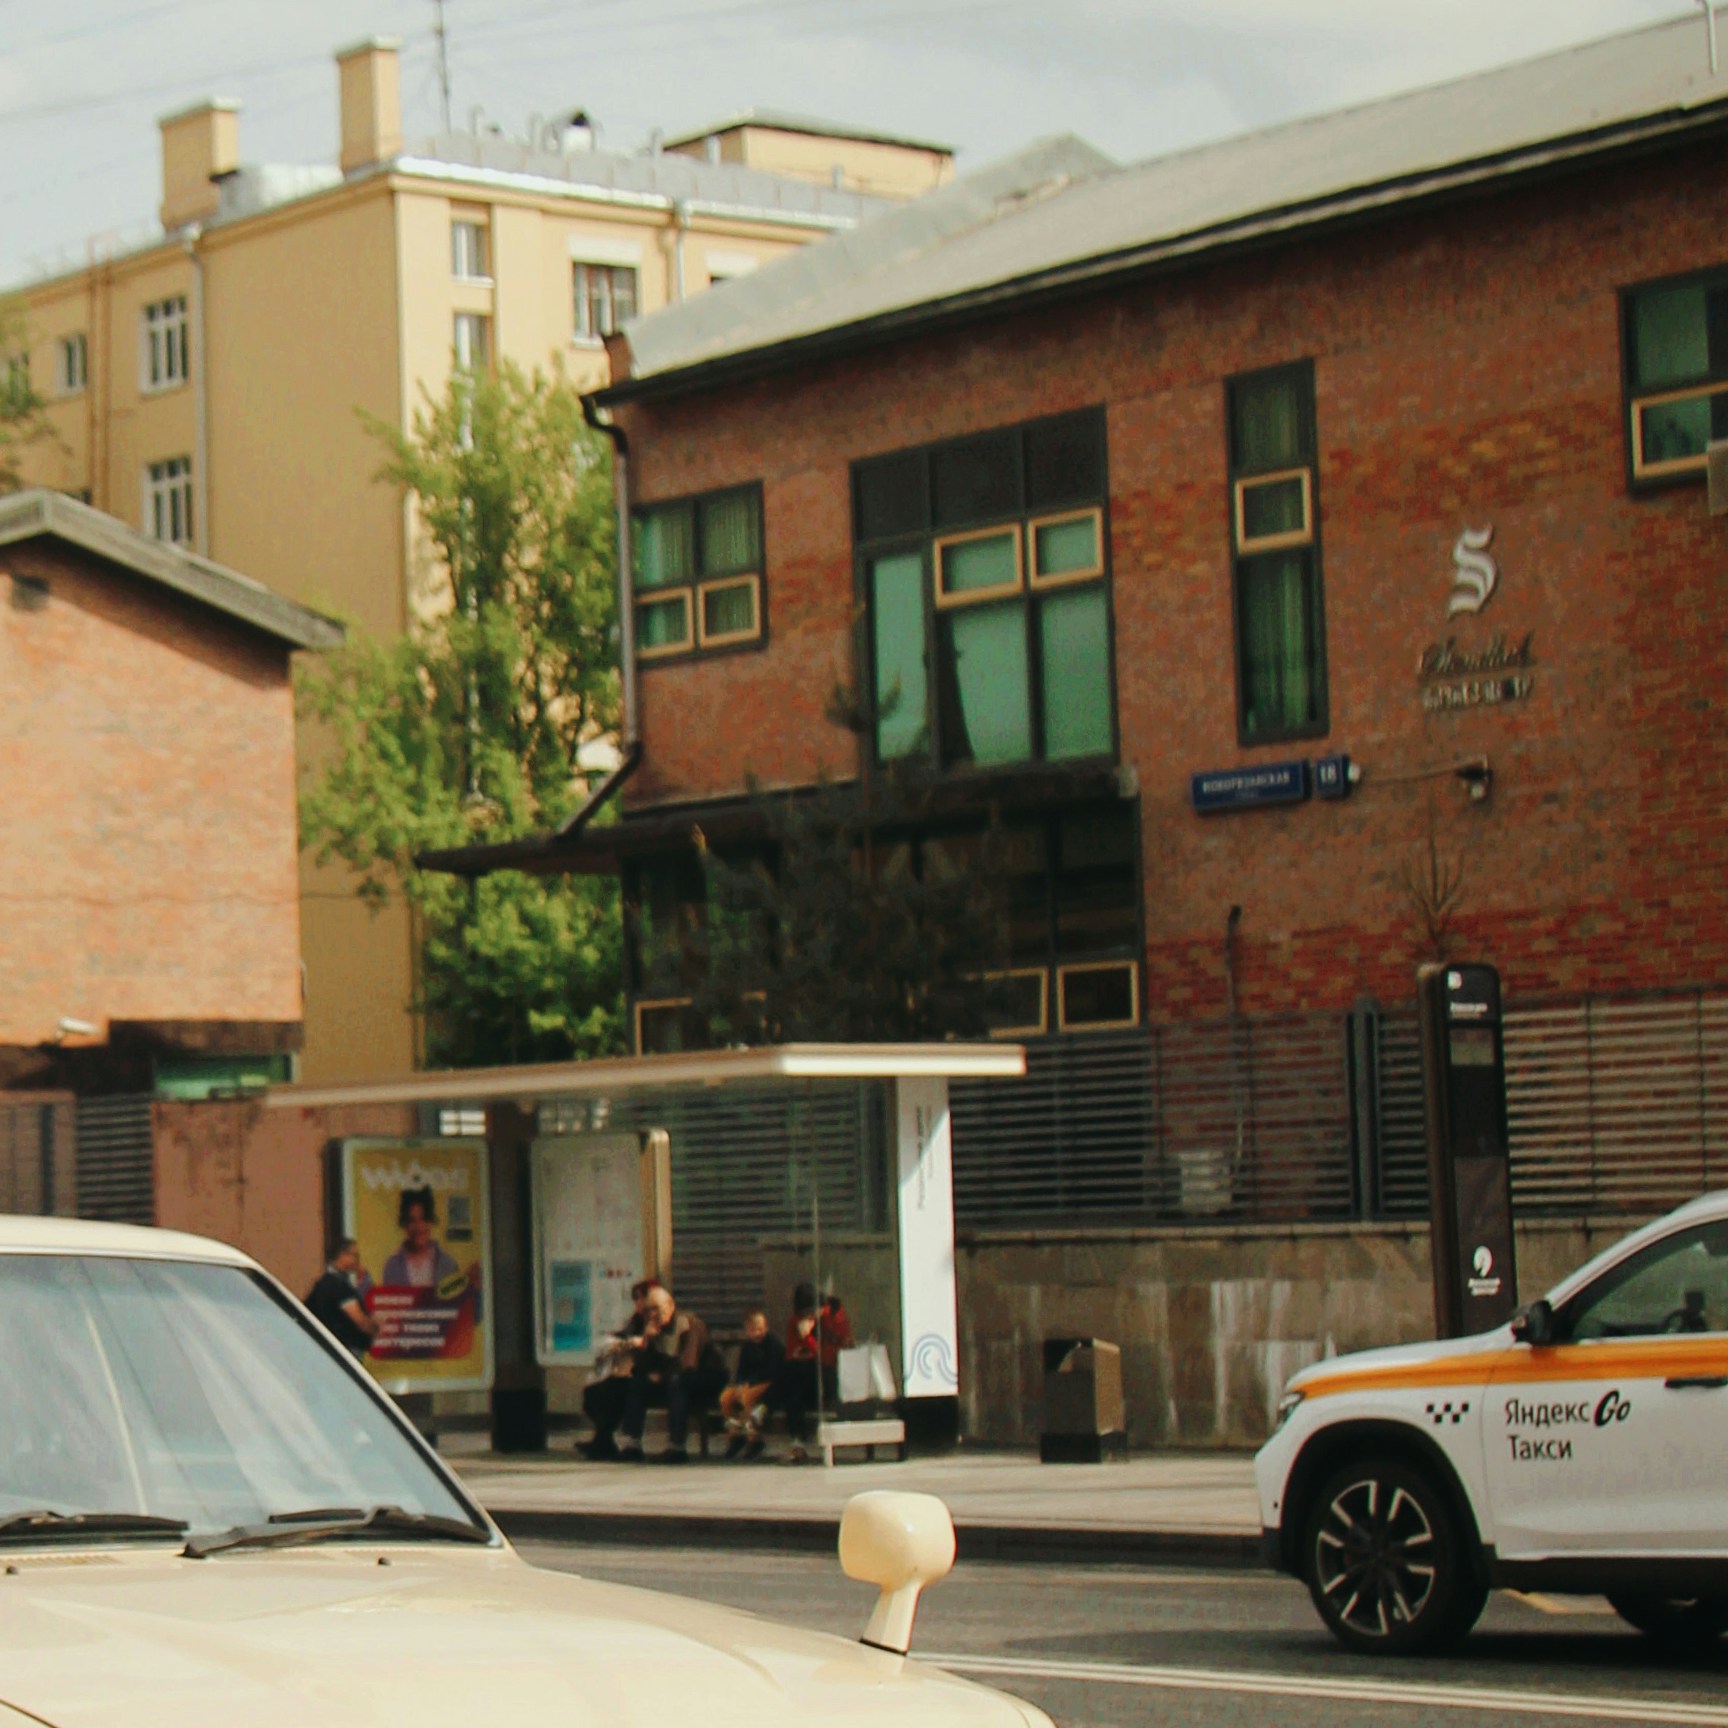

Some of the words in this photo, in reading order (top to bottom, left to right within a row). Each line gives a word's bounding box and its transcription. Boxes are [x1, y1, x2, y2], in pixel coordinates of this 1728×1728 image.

[1504, 1398, 1590, 1428] Яндекс
[1593, 1389, 1632, 1428] Go
[1508, 1434, 1573, 1461] Такси
